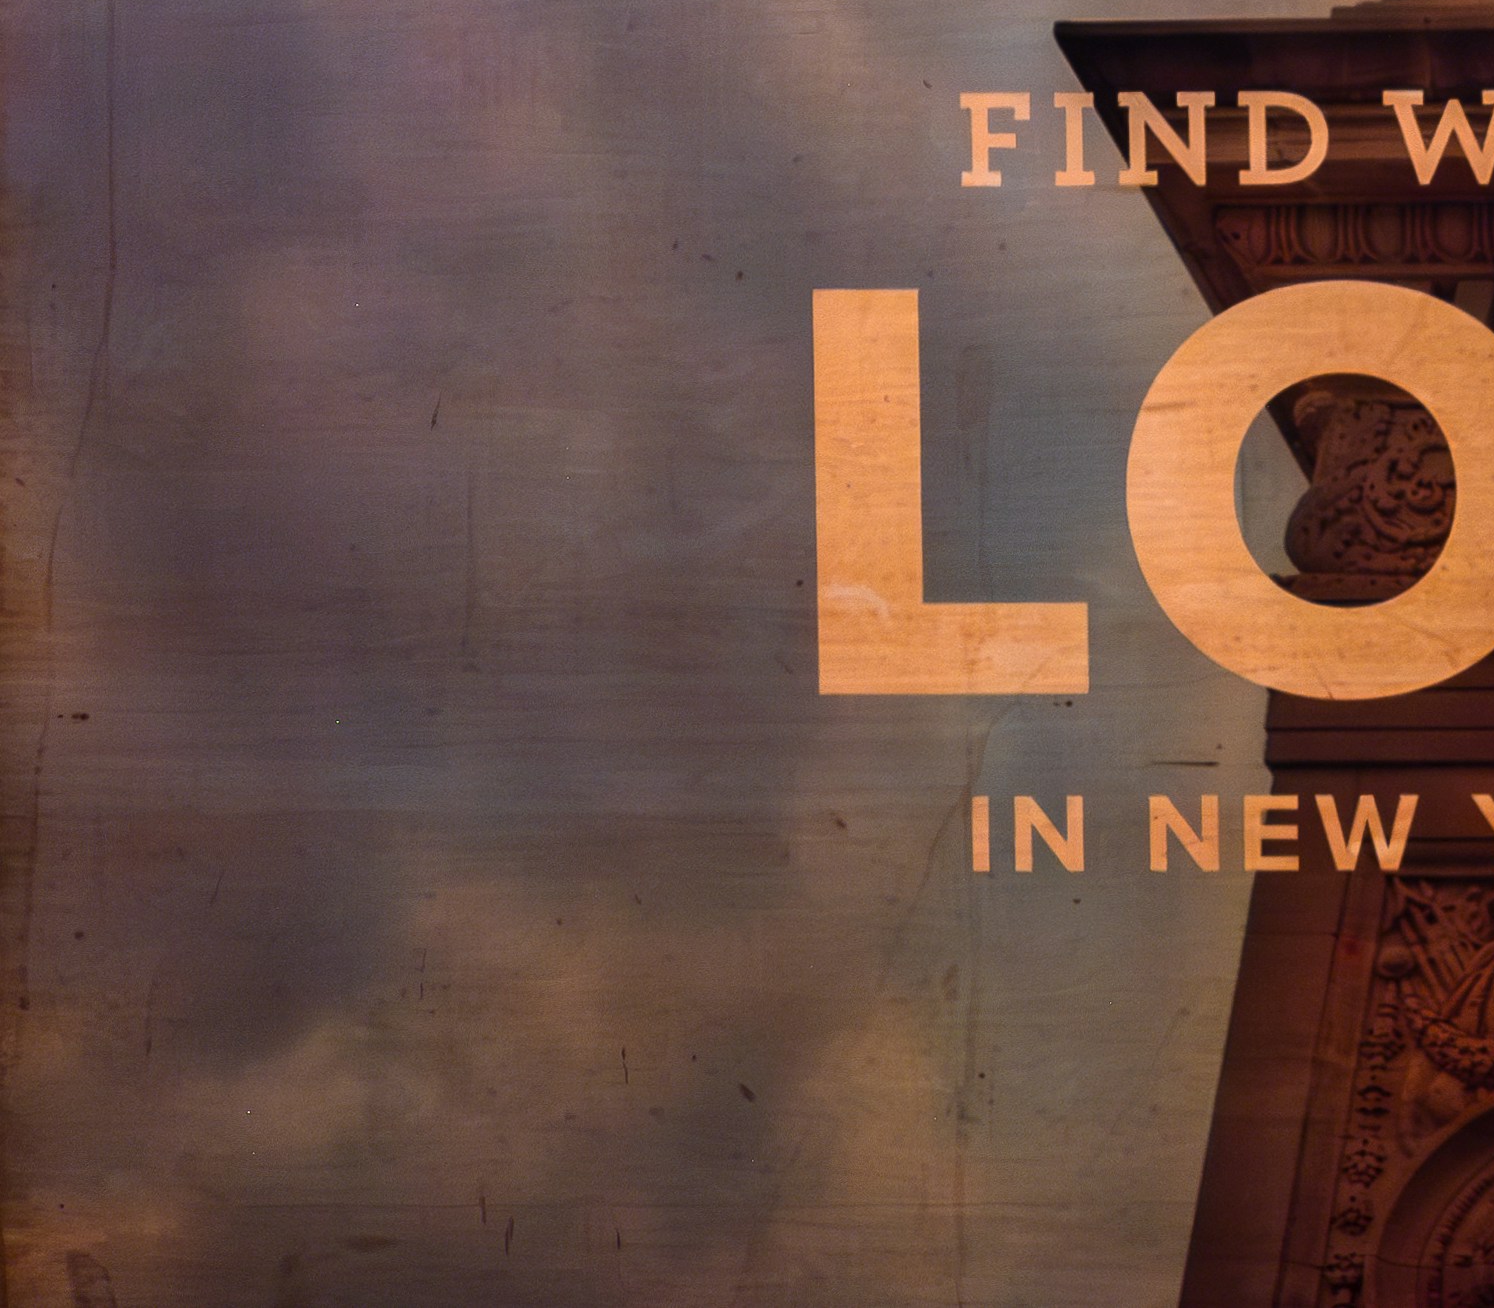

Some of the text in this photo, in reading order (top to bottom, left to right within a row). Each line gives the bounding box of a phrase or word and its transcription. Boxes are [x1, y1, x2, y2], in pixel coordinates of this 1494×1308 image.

[959, 90, 1330, 191] FIND
[970, 794, 1086, 874] IN
[1147, 792, 1420, 874] NEW
